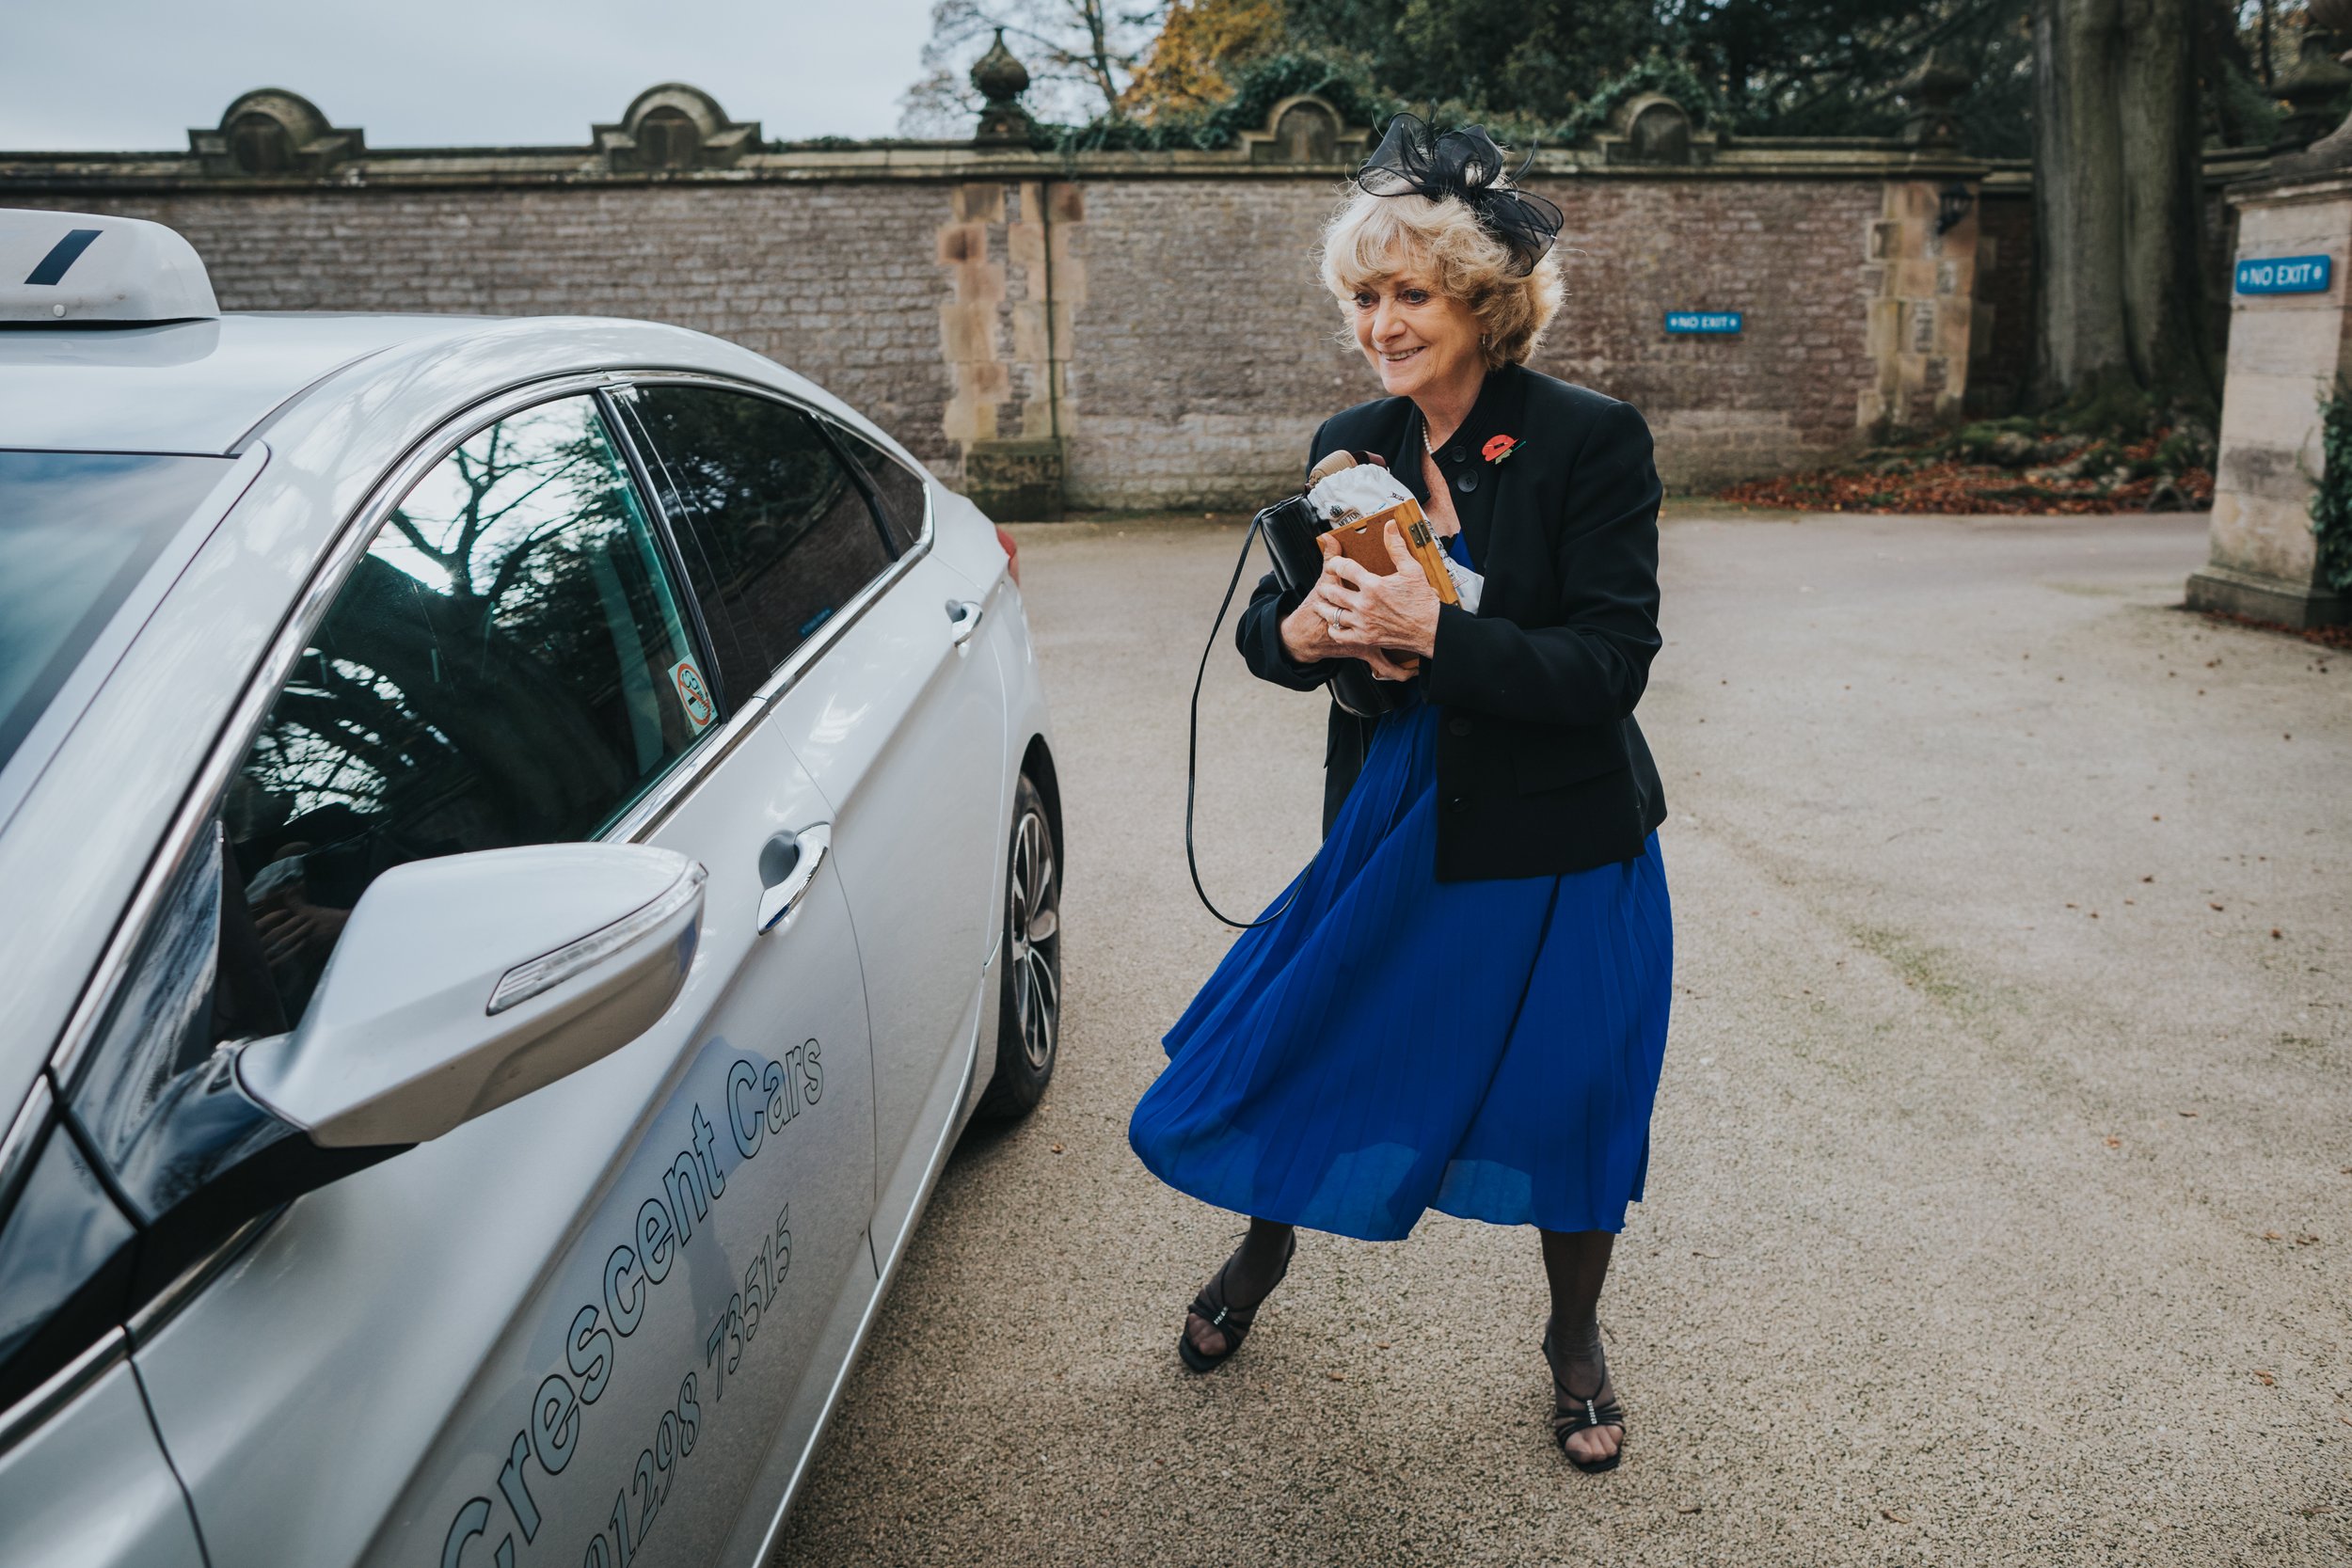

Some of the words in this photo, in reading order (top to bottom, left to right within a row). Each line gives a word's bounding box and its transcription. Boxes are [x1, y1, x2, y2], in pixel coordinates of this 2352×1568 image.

[2249, 265, 2273, 286] NO
[2277, 263, 2312, 286] EXIT
[1677, 315, 1699, 329] NO
[1701, 315, 1727, 329] EXIT
[727, 1037, 824, 1160] Cars
[707, 1202, 792, 1402] 73515
